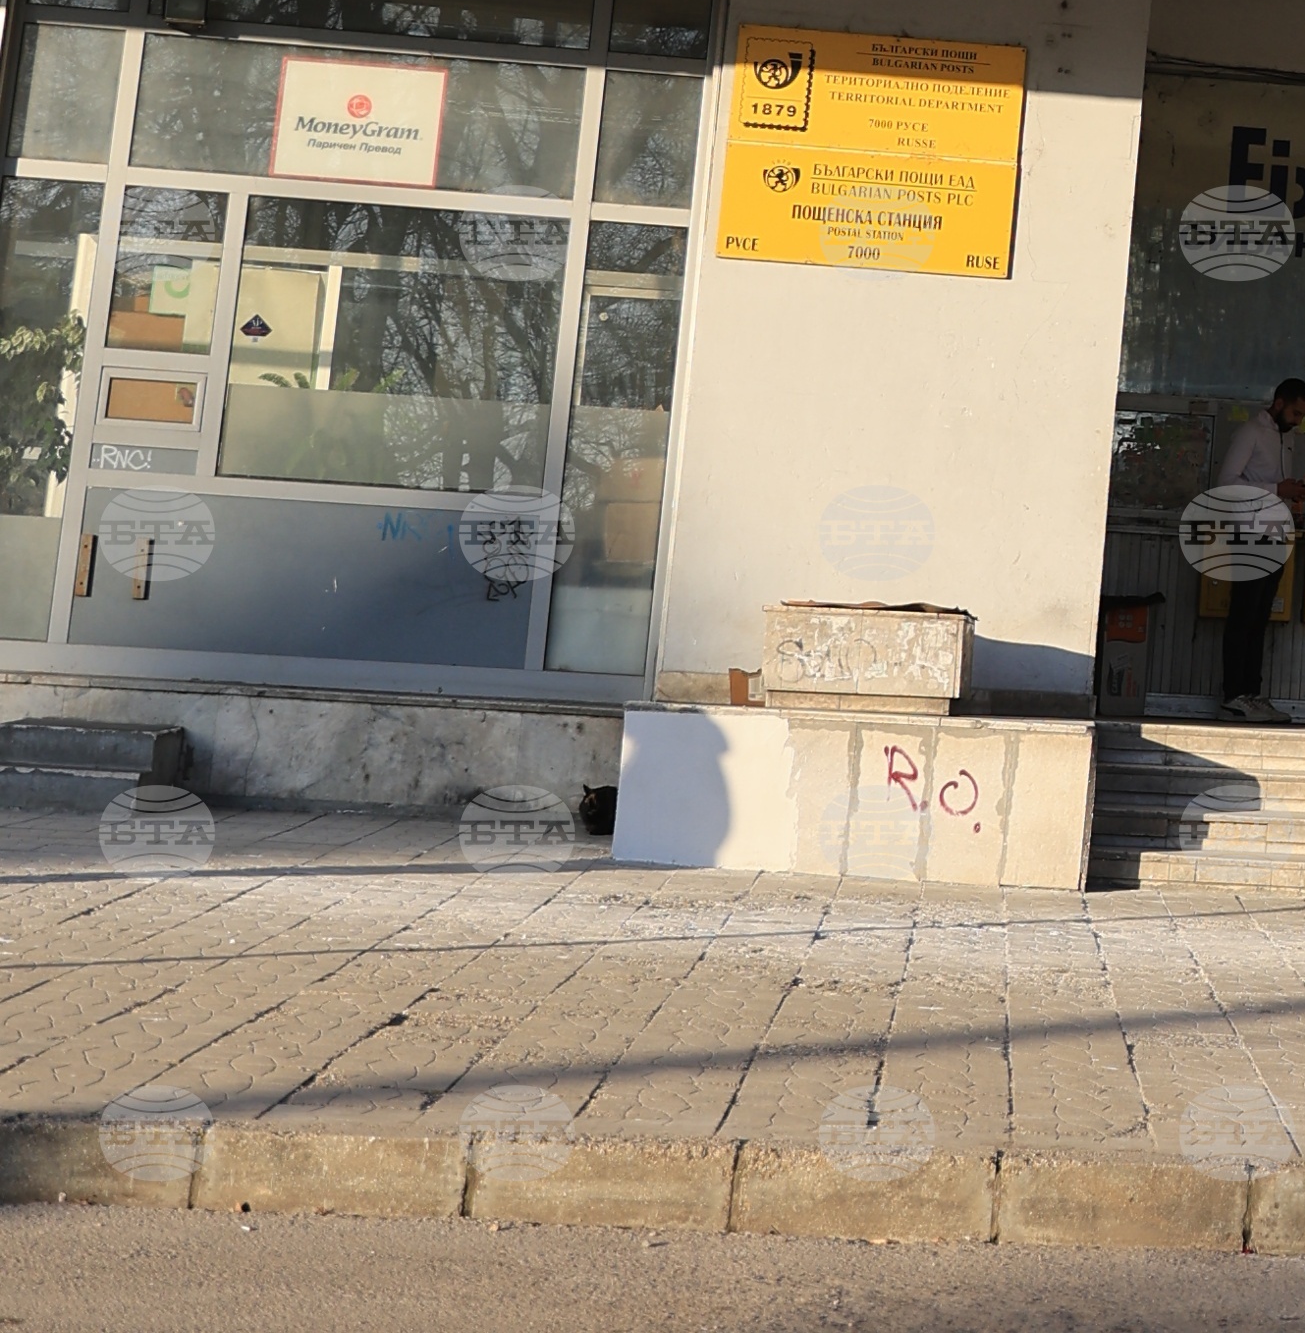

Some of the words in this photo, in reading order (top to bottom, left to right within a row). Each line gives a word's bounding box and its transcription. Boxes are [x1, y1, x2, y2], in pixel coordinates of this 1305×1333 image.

[872, 43, 938, 59] БЪЛГАРСКИ
[941, 48, 978, 60] ПОЩИ
[872, 58, 937, 72] BULGARIAN
[940, 63, 974, 74] POSTS
[825, 74, 929, 92] ТЕРИТОРИАЛНО
[932, 82, 1010, 98] ПОДЕЛЕНИЕ
[751, 103, 797, 117] 1879
[829, 91, 916, 107] TERRITORIAL
[919, 98, 1005, 114] DEPARTMENT
[294, 116, 421, 141] MoneyGram
[869, 118, 893, 130] 7000
[896, 121, 929, 132] РУСЕ
[307, 138, 356, 151] Паричен
[359, 142, 402, 155] Превод
[897, 137, 936, 149] RUSSE
[813, 163, 895, 182] БЪЛГАРСКИ
[899, 171, 944, 187] ПОЩИ
[811, 182, 892, 201] BULGARIAN
[897, 189, 942, 204] POSTS
[947, 193, 974, 207] PLC
[792, 205, 872, 226] ПОЩЕНСКА
[877, 212, 943, 230] СТАНЦИЯ
[827, 226, 863, 240] POSTAL
[865, 230, 904, 241] STATION
[725, 236, 759, 252] РУСЕ
[848, 246, 880, 260] 7000
[966, 255, 1000, 270] RUSE
